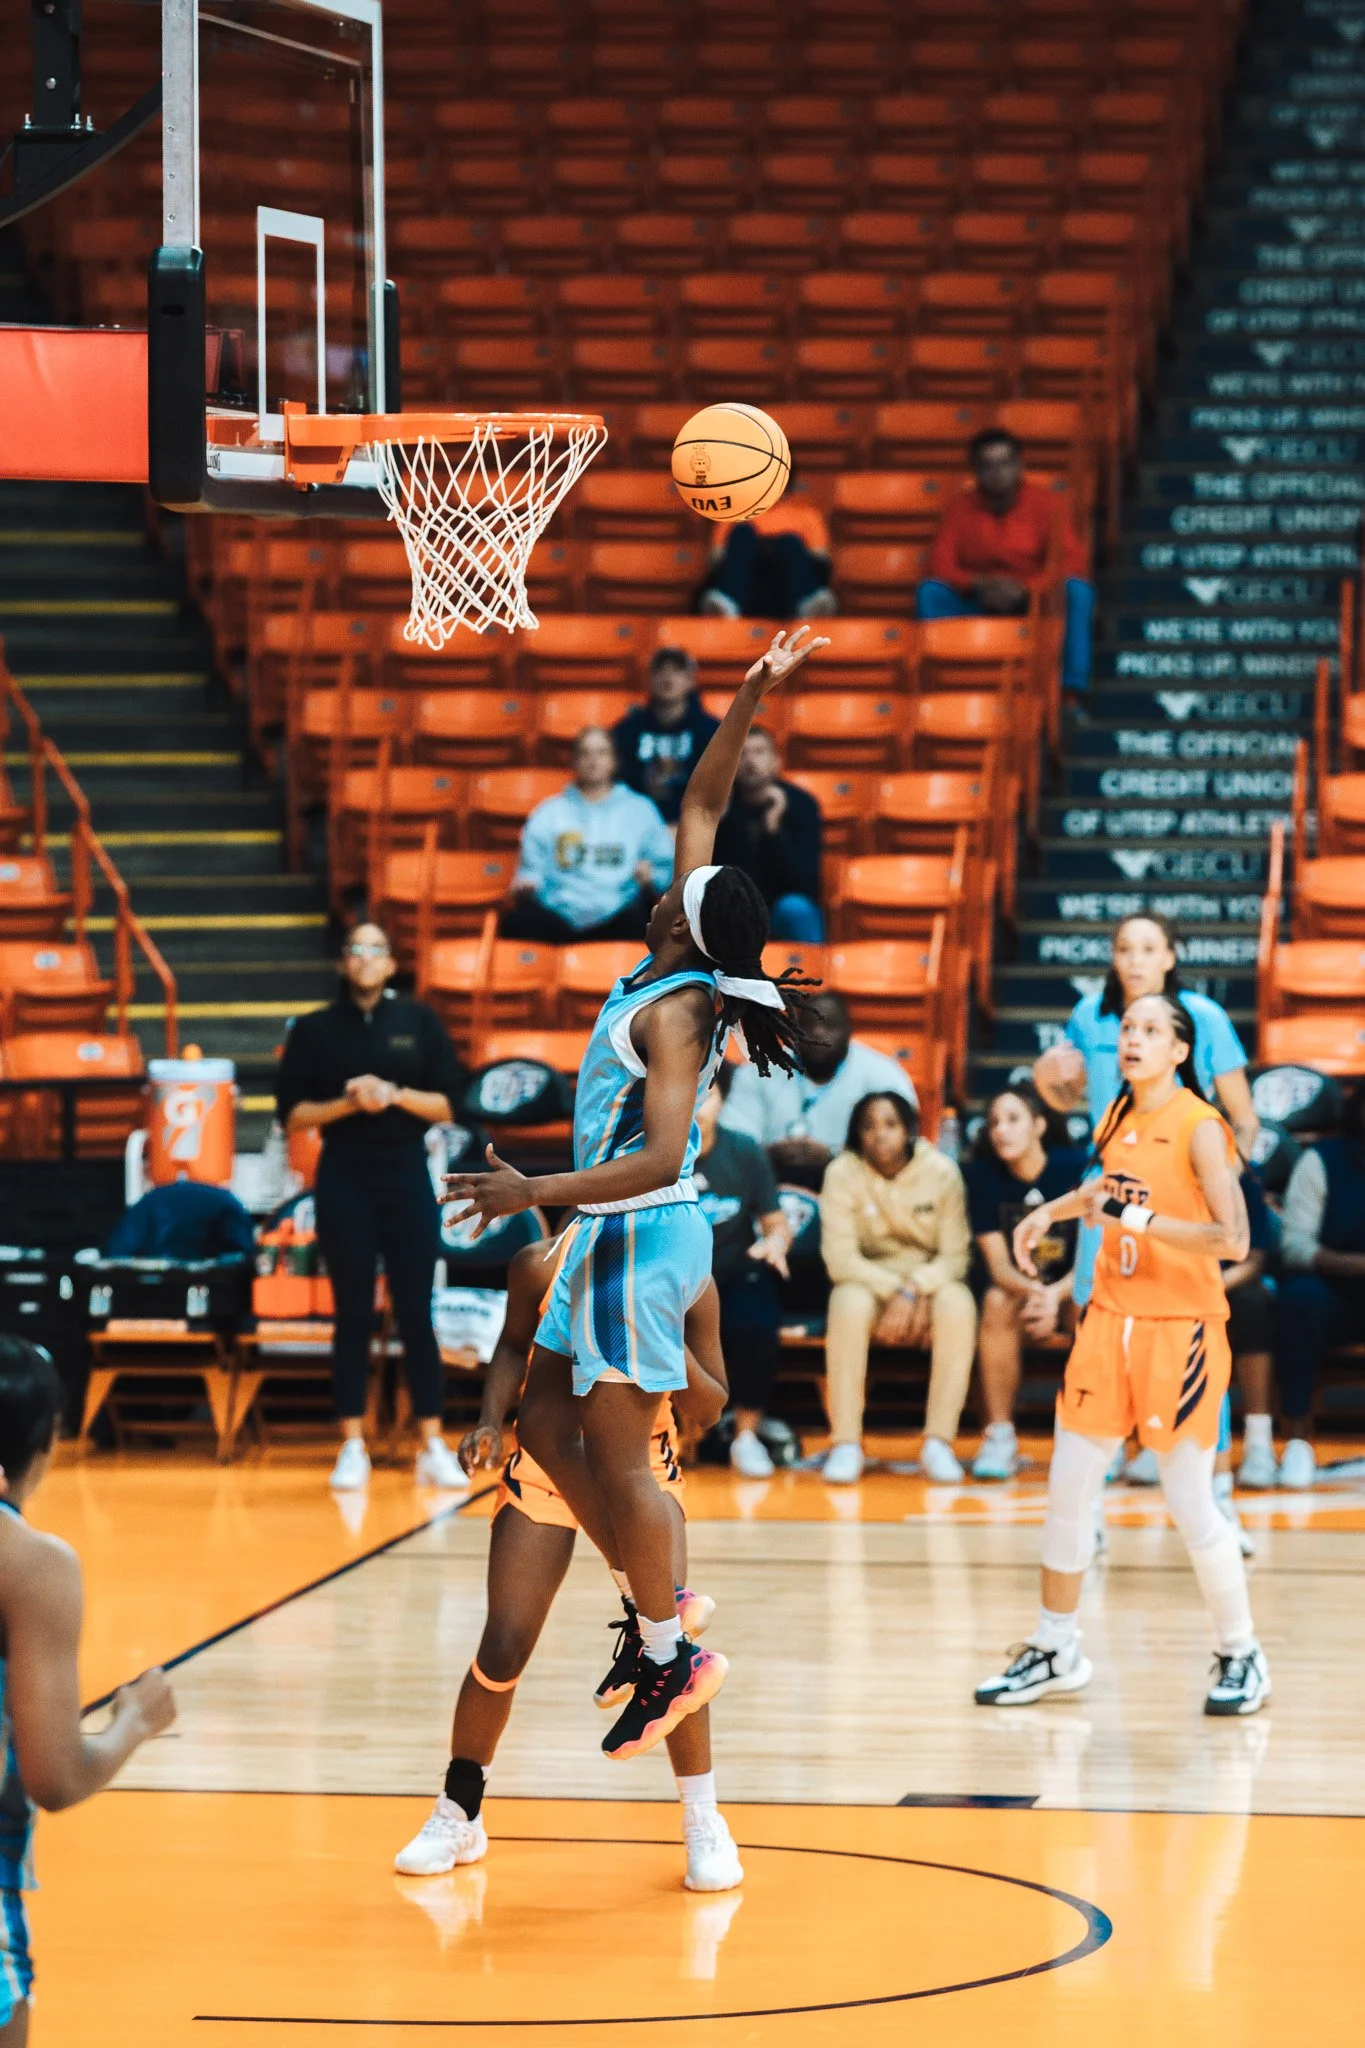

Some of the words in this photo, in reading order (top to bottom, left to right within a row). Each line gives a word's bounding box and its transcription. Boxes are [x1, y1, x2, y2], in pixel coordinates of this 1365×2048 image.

[1115, 730, 1174, 759] THE
[1099, 768, 1207, 799] CREDIT
[1062, 809, 1100, 838] OF
[1104, 809, 1177, 838] UTEP
[1154, 850, 1263, 881] GECU
[1119, 1234, 1138, 1277] 0
